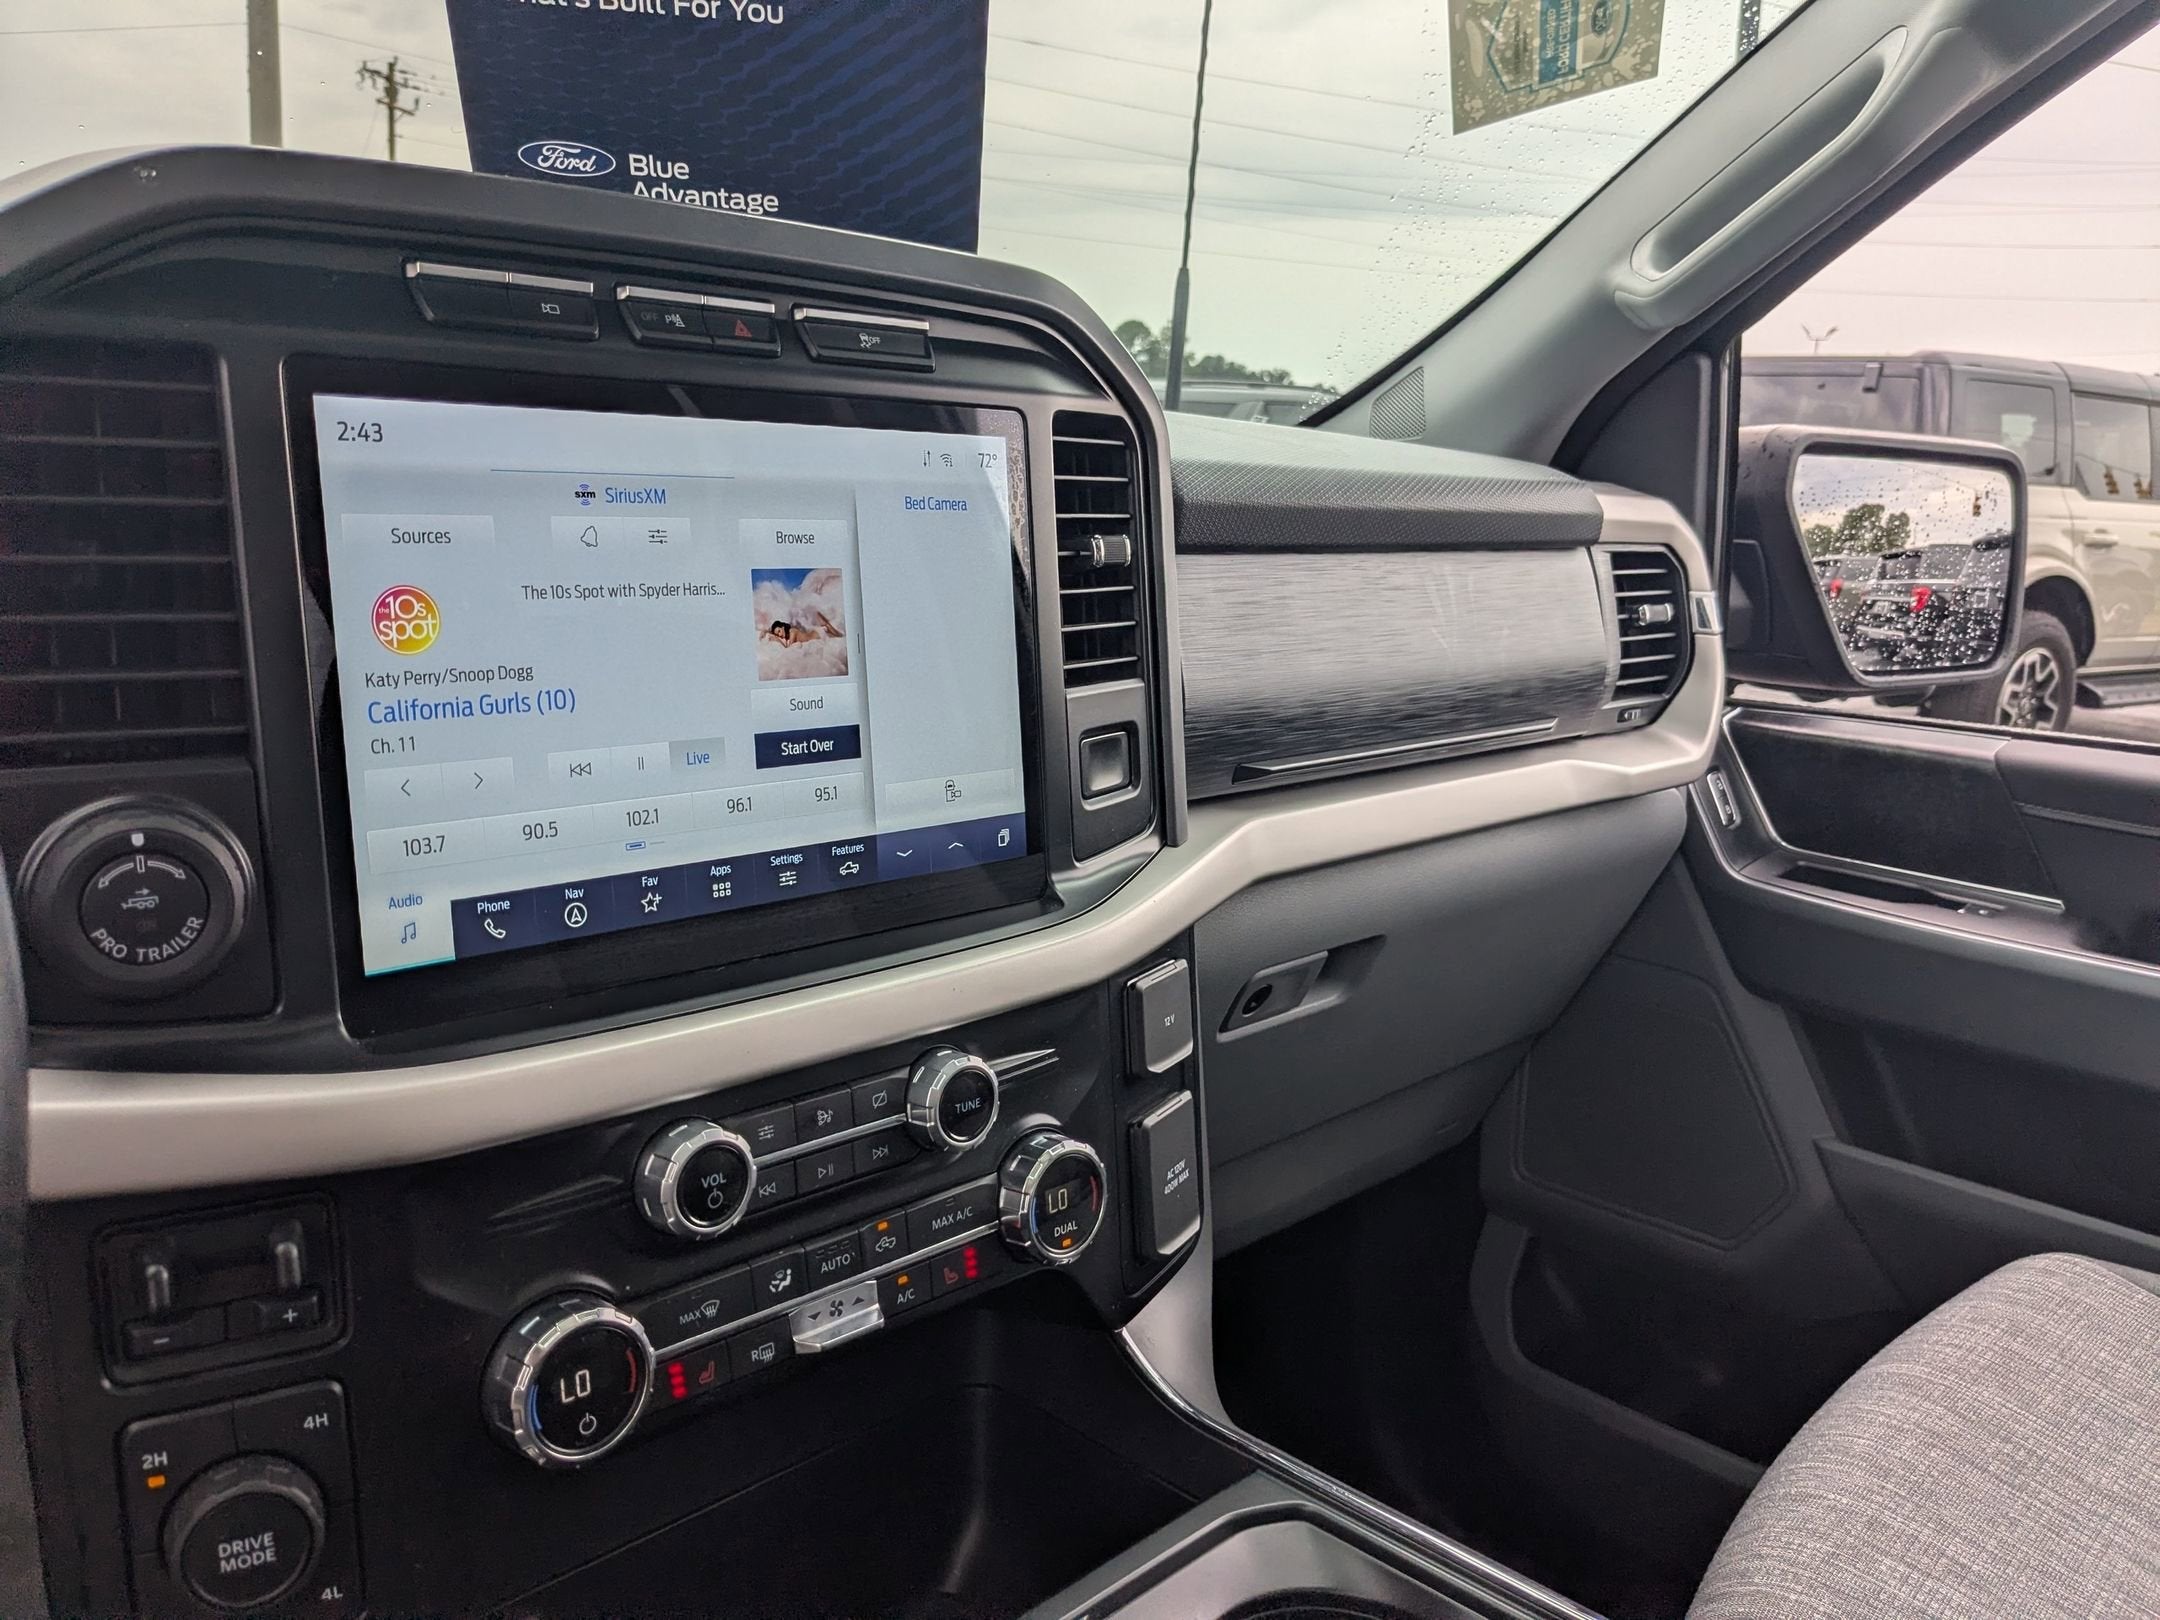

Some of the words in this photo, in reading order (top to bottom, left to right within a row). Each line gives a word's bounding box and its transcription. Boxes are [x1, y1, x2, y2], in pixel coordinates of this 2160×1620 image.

[674, 0, 720, 19] For
[729, 0, 785, 25] You
[537, 145, 597, 173] Ford
[628, 153, 690, 180] Blue
[633, 181, 780, 215] Advantage
[869, 336, 882, 345] OFF
[336, 421, 384, 443] 2:43
[977, 453, 998, 469] 72°
[574, 490, 596, 499] sxm
[604, 487, 667, 504] SiriusXM
[905, 496, 926, 511] Bed
[928, 497, 968, 512] Camera
[391, 528, 452, 545] Sources
[776, 531, 815, 545] Browse
[521, 585, 548, 600] The
[550, 584, 572, 600] 10s
[574, 583, 605, 601] Spot
[607, 583, 636, 598] with
[639, 582, 681, 600] Spyder
[385, 595, 427, 619] 10s
[379, 613, 437, 649] spot
[365, 672, 400, 689] Katy
[404, 667, 495, 687] Perry/Snoop
[498, 664, 535, 682] Dogg
[367, 696, 474, 724] California
[480, 691, 531, 716] Gurls
[537, 688, 576, 716] (10)
[789, 696, 824, 712] Sound
[781, 740, 808, 756] Start
[810, 738, 834, 753] Over
[686, 751, 711, 766] Live
[814, 786, 838, 802] 95.1
[726, 797, 752, 814] 96.1
[625, 808, 660, 827] 102.1
[522, 821, 558, 841] 90.5
[402, 836, 446, 857] 103.7
[831, 843, 865, 857] Features
[770, 853, 804, 867] Settings
[710, 864, 732, 877] Apps
[641, 875, 659, 888] Fav
[388, 893, 423, 910] Audio
[564, 888, 585, 900] Nav
[477, 898, 511, 914] Phone
[90, 928, 128, 959] PRO
[136, 916, 204, 963] TRAILER
[954, 1097, 981, 1114] TUNE
[701, 1172, 728, 1189] VOL
[932, 1213, 954, 1231] MAX
[956, 1205, 974, 1224] A/C
[1053, 1219, 1078, 1238] DUAL
[820, 1254, 851, 1275] AUTO
[896, 1288, 916, 1306] A/C
[679, 1309, 701, 1325] MAX
[303, 1413, 329, 1430] 4H
[141, 1451, 169, 1470] 2H
[217, 1531, 275, 1558] DRIVE
[219, 1547, 277, 1573] MODE
[321, 1586, 343, 1601] 4L
